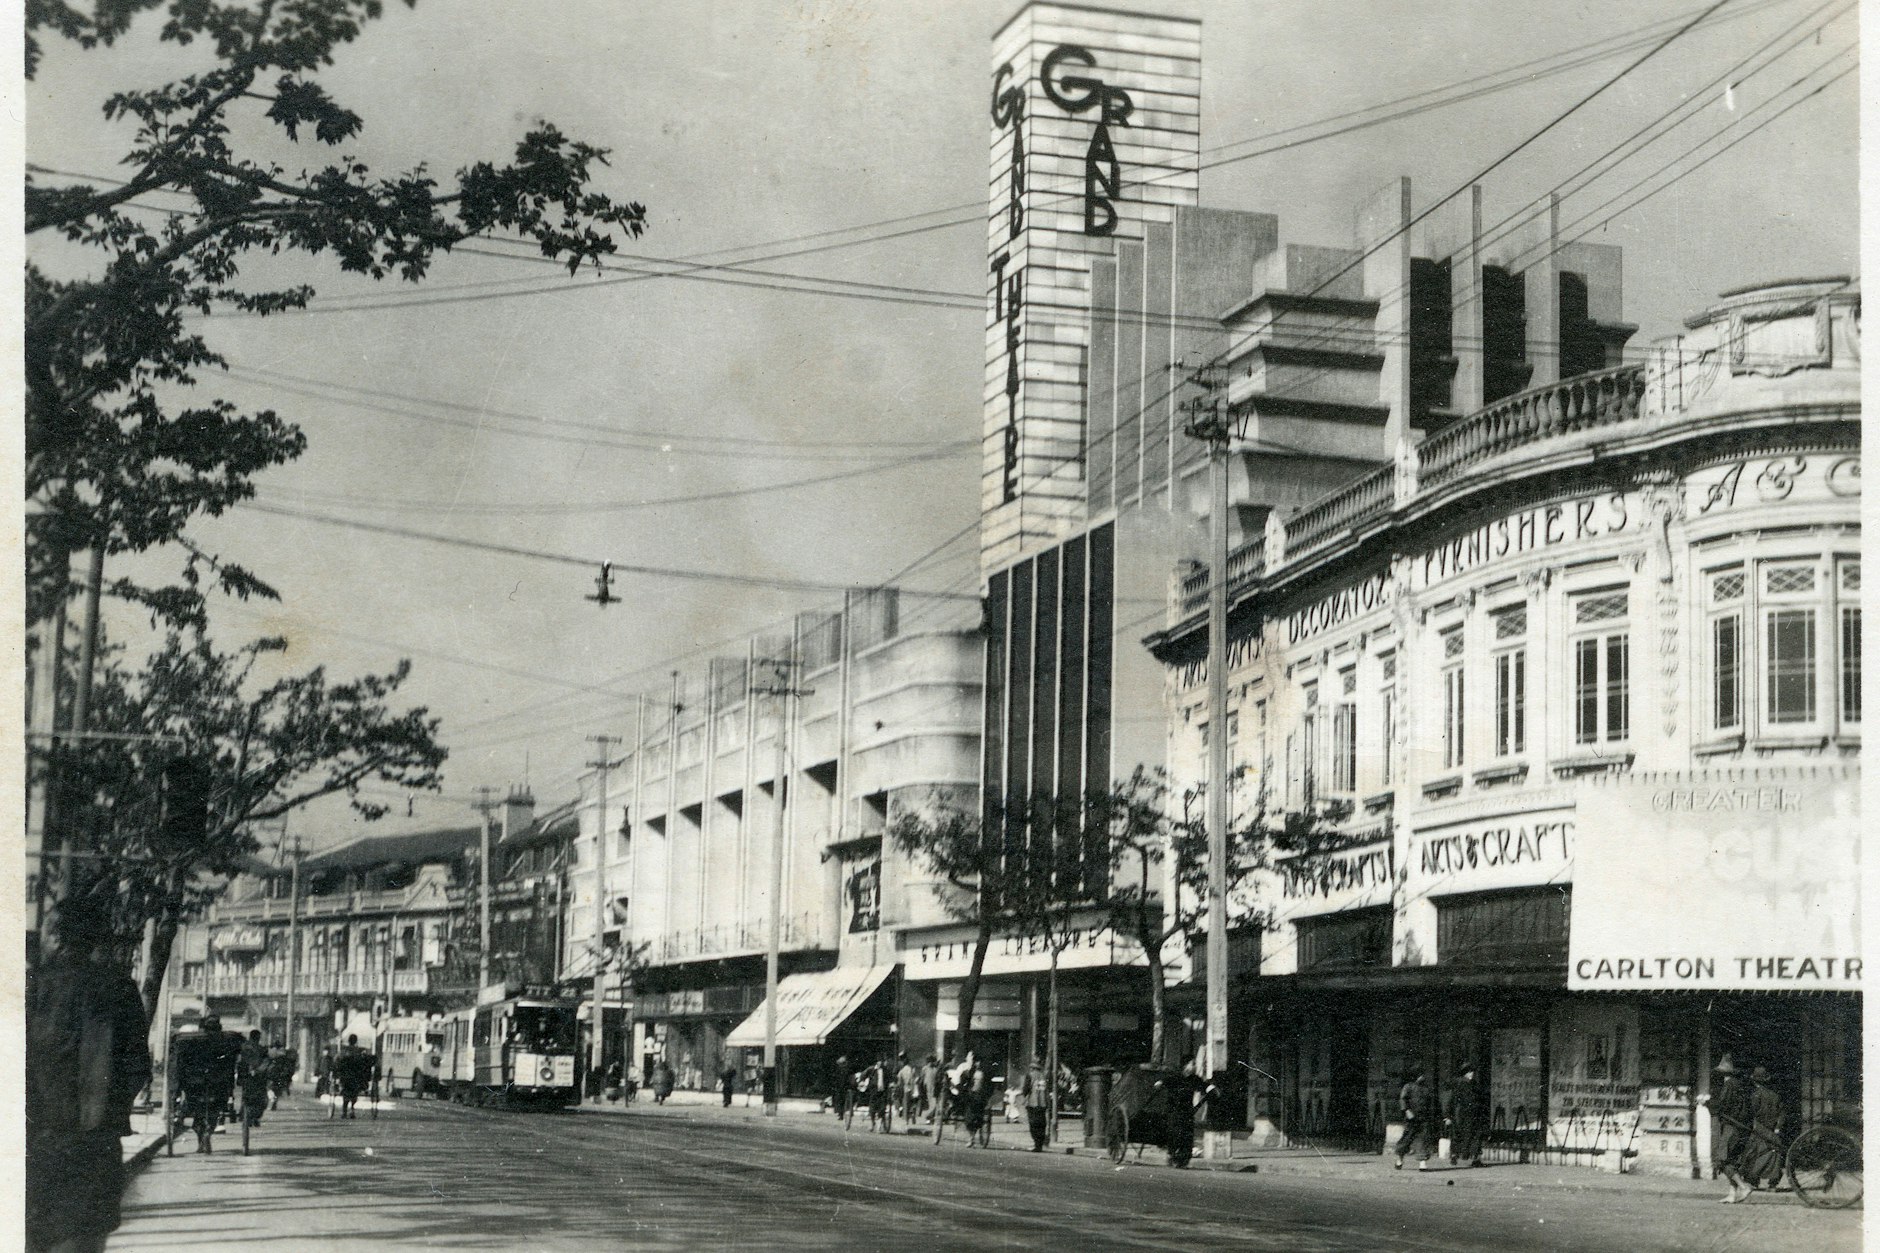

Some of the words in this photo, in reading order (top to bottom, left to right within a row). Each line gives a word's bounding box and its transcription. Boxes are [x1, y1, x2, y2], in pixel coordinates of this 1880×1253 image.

[991, 61, 1026, 241] GRAND
[1040, 43, 1134, 237] GRAND
[990, 250, 1023, 504] THEATRE
[1421, 834, 1464, 876] ARTS
[1482, 822, 1576, 867] CRAFT
[1576, 957, 1716, 981] CARLTON
[1733, 956, 1863, 981] THEATR
